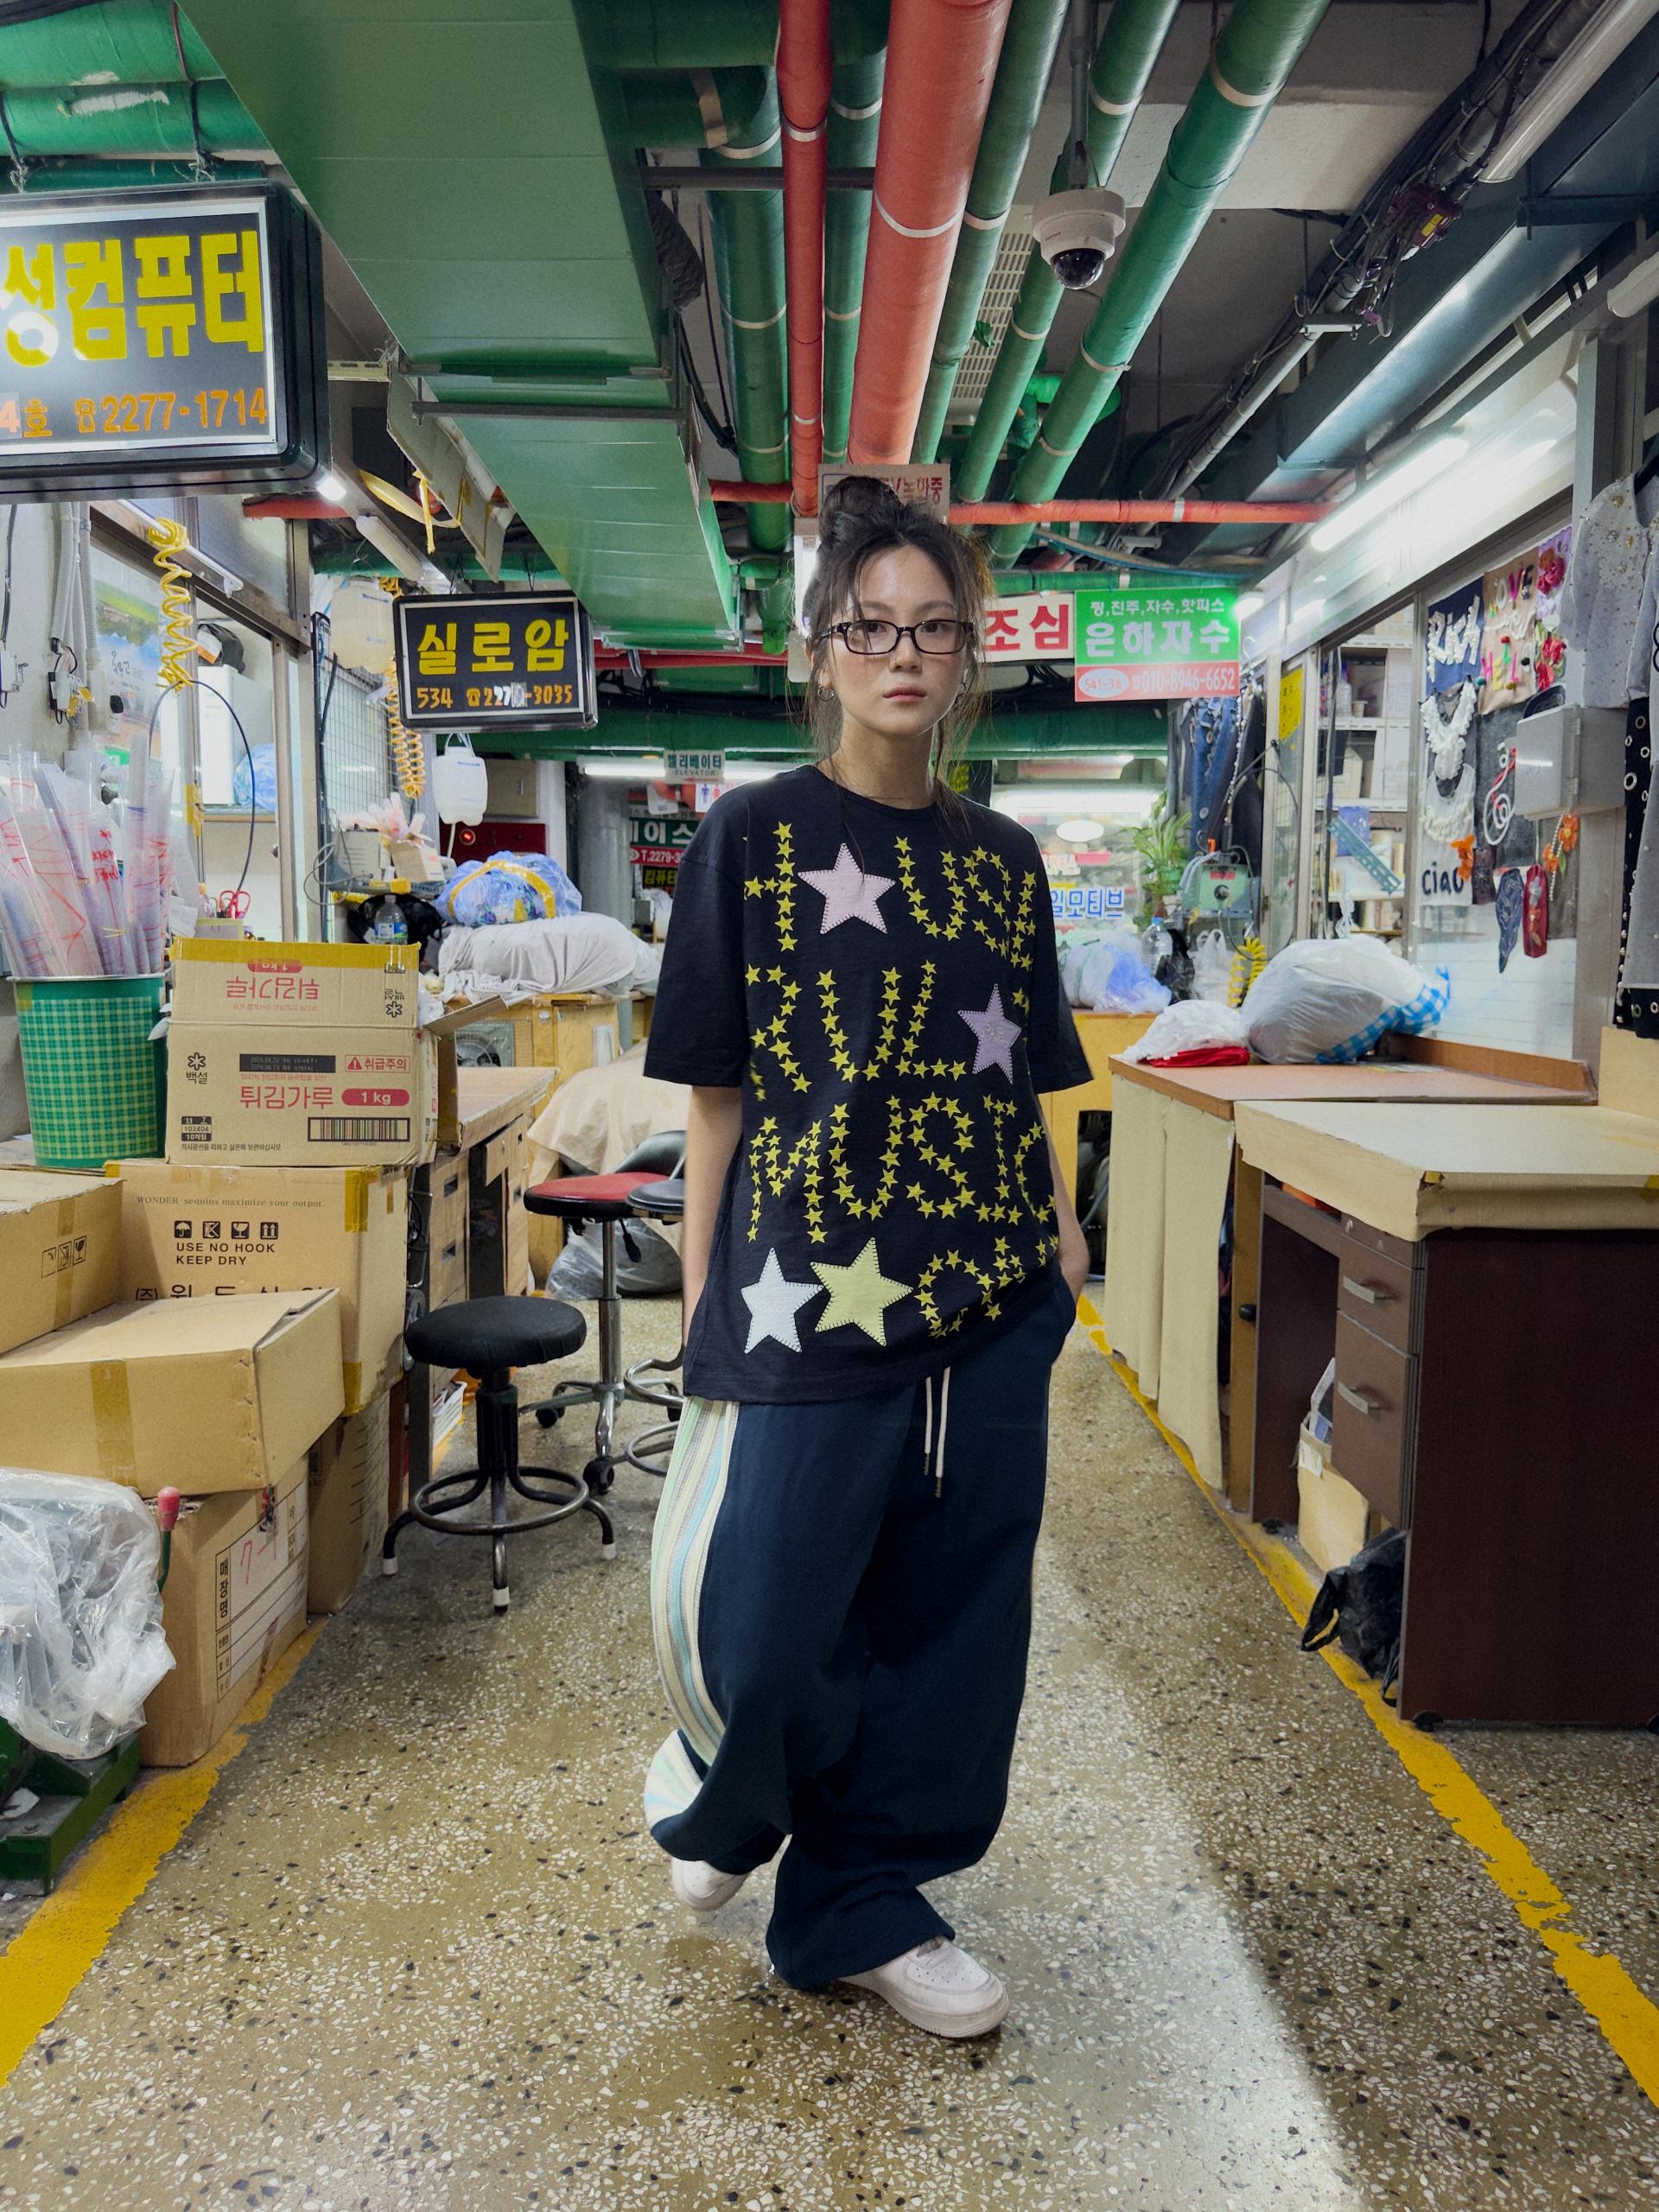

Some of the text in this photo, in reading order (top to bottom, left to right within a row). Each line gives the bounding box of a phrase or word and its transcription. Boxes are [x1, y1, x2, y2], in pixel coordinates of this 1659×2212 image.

[3, 230, 264, 367] 성컴퓨터
[102, 387, 268, 434] 2277-1714
[984, 604, 1070, 652] 조심
[1084, 619, 1230, 658] 은하자수
[417, 618, 569, 676] 실로암
[416, 687, 454, 709] 534
[226, 976, 321, 1000] 튀김가루
[364, 1057, 407, 1071] 취급주의
[186, 1071, 208, 1085] 백설
[239, 1085, 334, 1110] 튀김가루
[373, 1090, 391, 1105] kg
[137, 1195, 180, 1205] WONDER
[269, 1199, 290, 1209] your
[176, 1242, 276, 1253] USE NO HOOK
[176, 1255, 247, 1266] KEEP DRY
